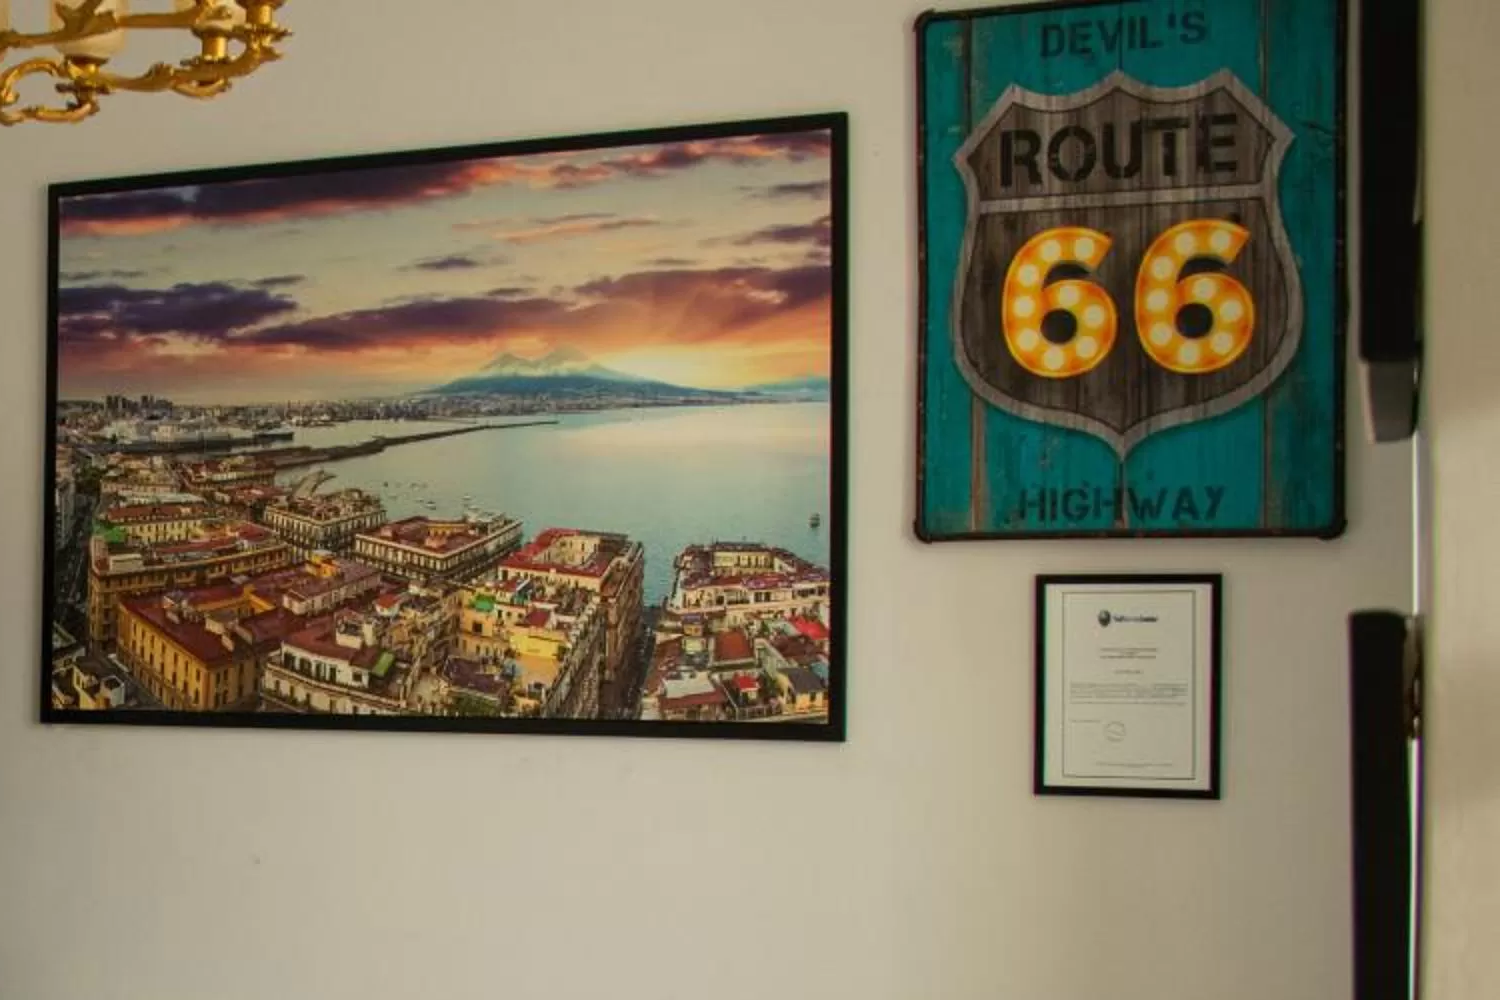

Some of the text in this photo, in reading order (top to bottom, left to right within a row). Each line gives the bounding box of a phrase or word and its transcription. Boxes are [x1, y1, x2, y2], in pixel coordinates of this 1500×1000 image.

[1040, 11, 1208, 59] DEVIL'S
[1000, 113, 1238, 188] ROUTE
[1002, 217, 1255, 378] 66
[1019, 485, 1226, 523] HIGHWAY
